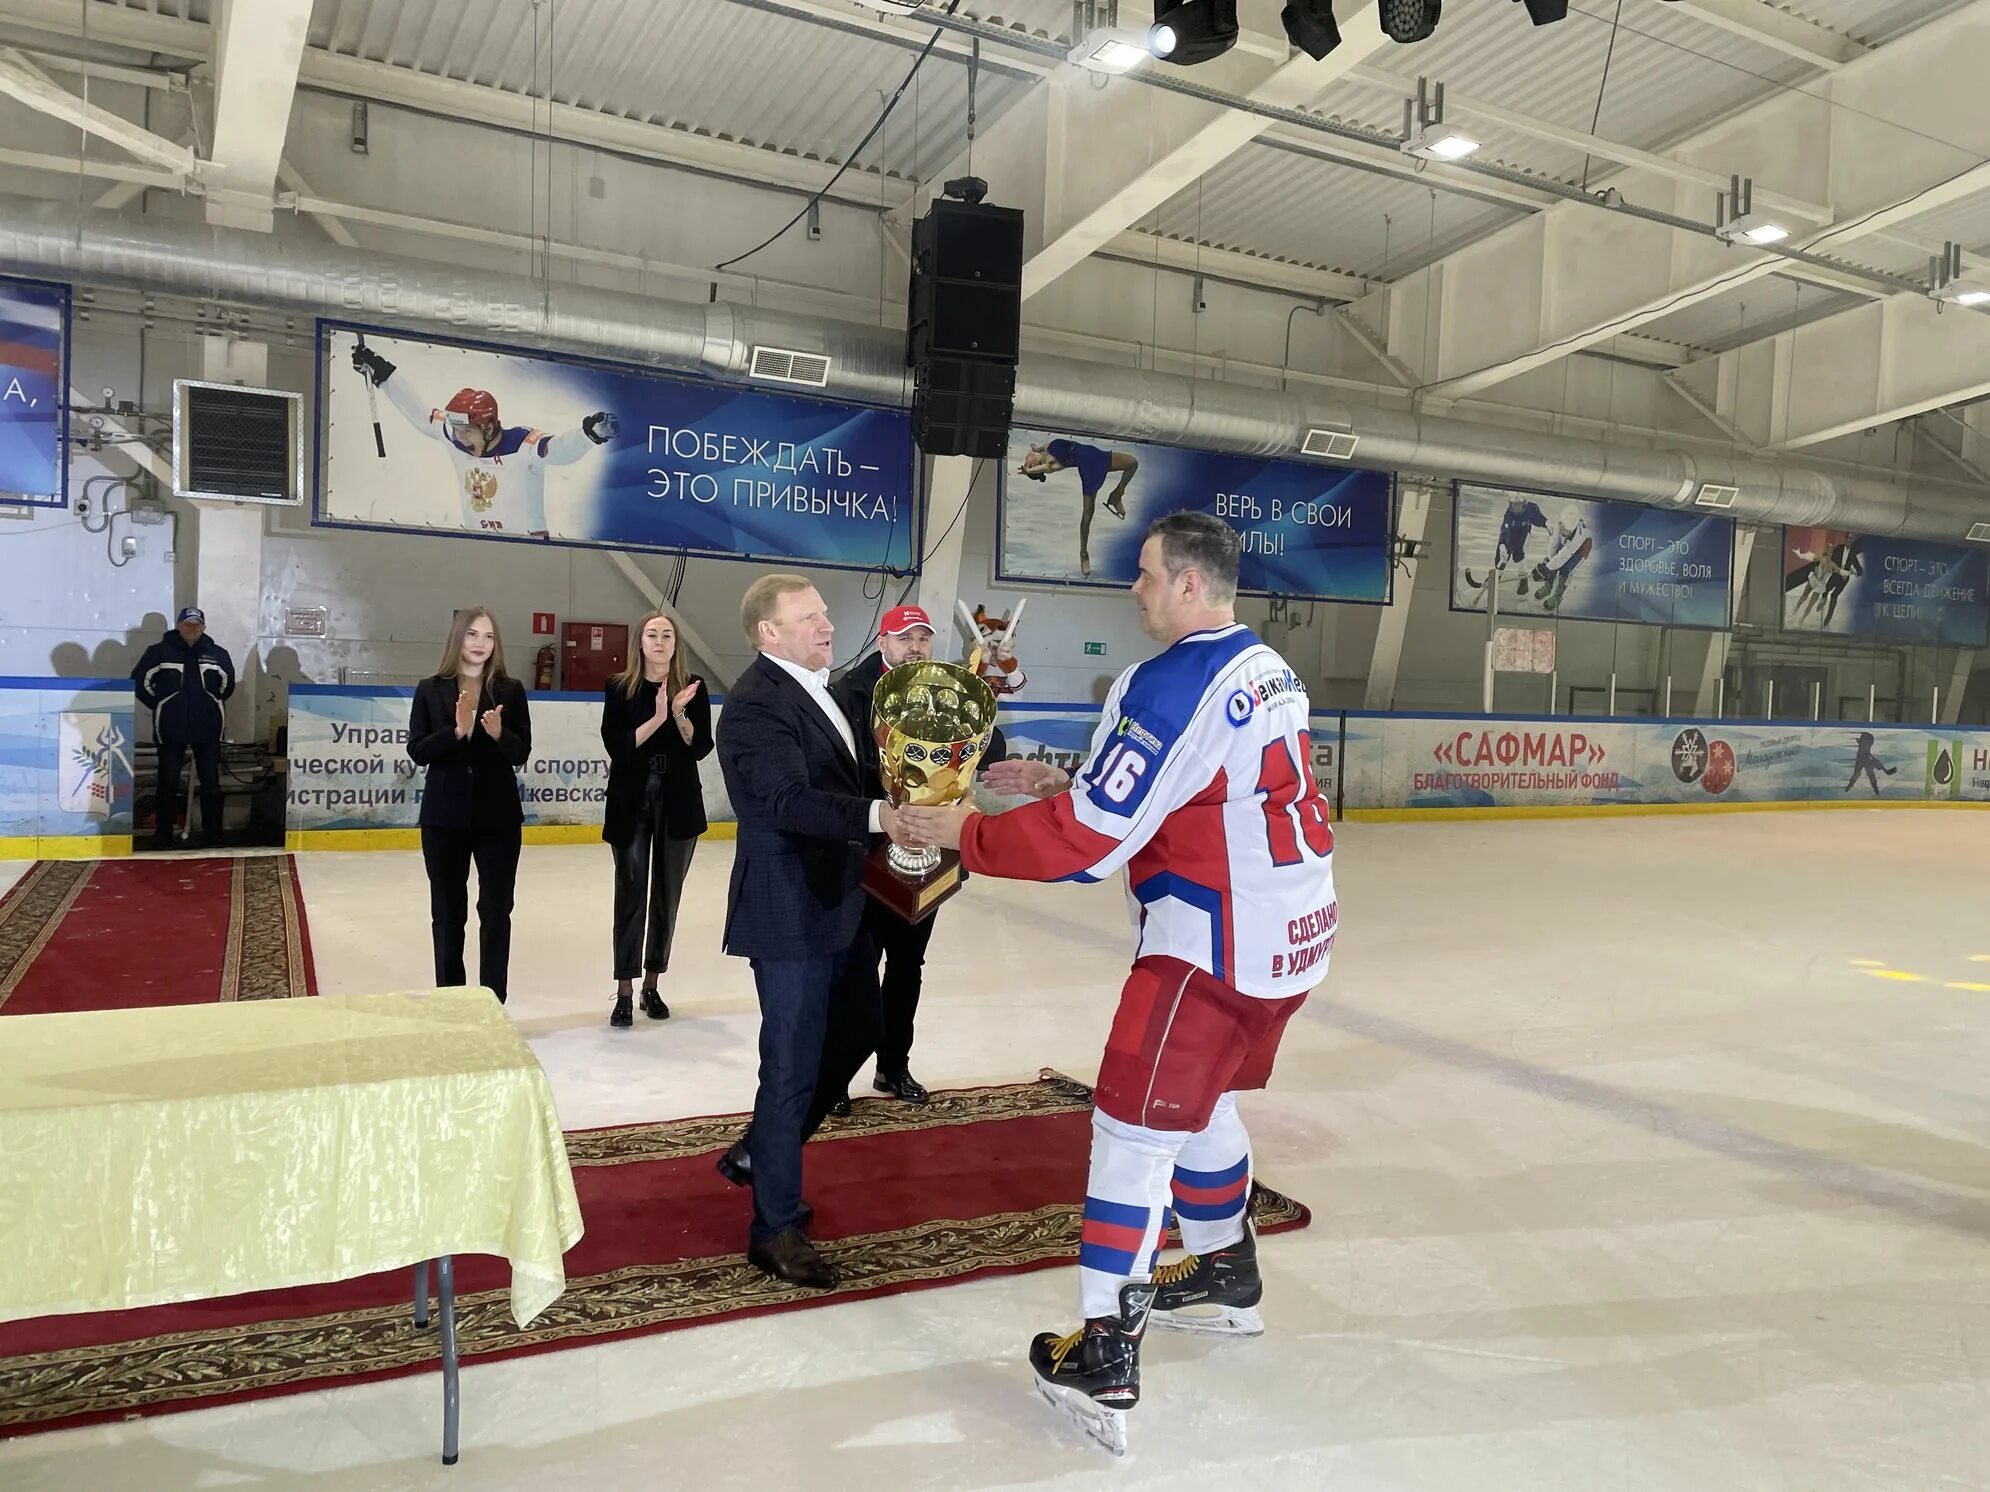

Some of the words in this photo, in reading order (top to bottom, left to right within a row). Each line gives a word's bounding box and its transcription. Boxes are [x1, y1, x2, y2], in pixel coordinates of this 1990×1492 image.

[648, 425, 852, 477] ПОБЕЖДАТЬ
[647, 469, 719, 503] ЭТО
[734, 478, 897, 523] ПРИВЫЧКА!
[1216, 493, 1262, 520] ВЕРЬ
[1272, 499, 1283, 521] В
[1291, 501, 1352, 529] СВОИ
[1237, 530, 1284, 556] ИЛЫ!
[1619, 534, 1656, 552] СПОРТ
[1667, 539, 1689, 556] ЭТО
[1618, 557, 1680, 578] ЗДОРОВЬЕ,
[1682, 563, 1712, 579] ВОЛЯ
[1884, 555, 1919, 573] СПОРТ
[1928, 560, 1949, 577] ЭТО
[1617, 583, 1626, 593] И
[1883, 578, 1920, 597] ВСЕГДА
[1922, 582, 1975, 603] ДВИЖЕНИЕ
[330, 722, 409, 748] Управ
[1433, 731, 1606, 767] «САФМАР»
[1973, 749, 1990, 771] Н
[534, 759, 611, 779] спорту
[1091, 742, 1147, 803] 16
[1414, 769, 1578, 791] БЛАГОТВОРИТЕЛЬНЫЙ
[1580, 772, 1620, 792] ФОНД
[286, 788, 405, 810] истрации
[1288, 900, 1338, 946] СДЕЛАНО
[1272, 954, 1284, 972] В
